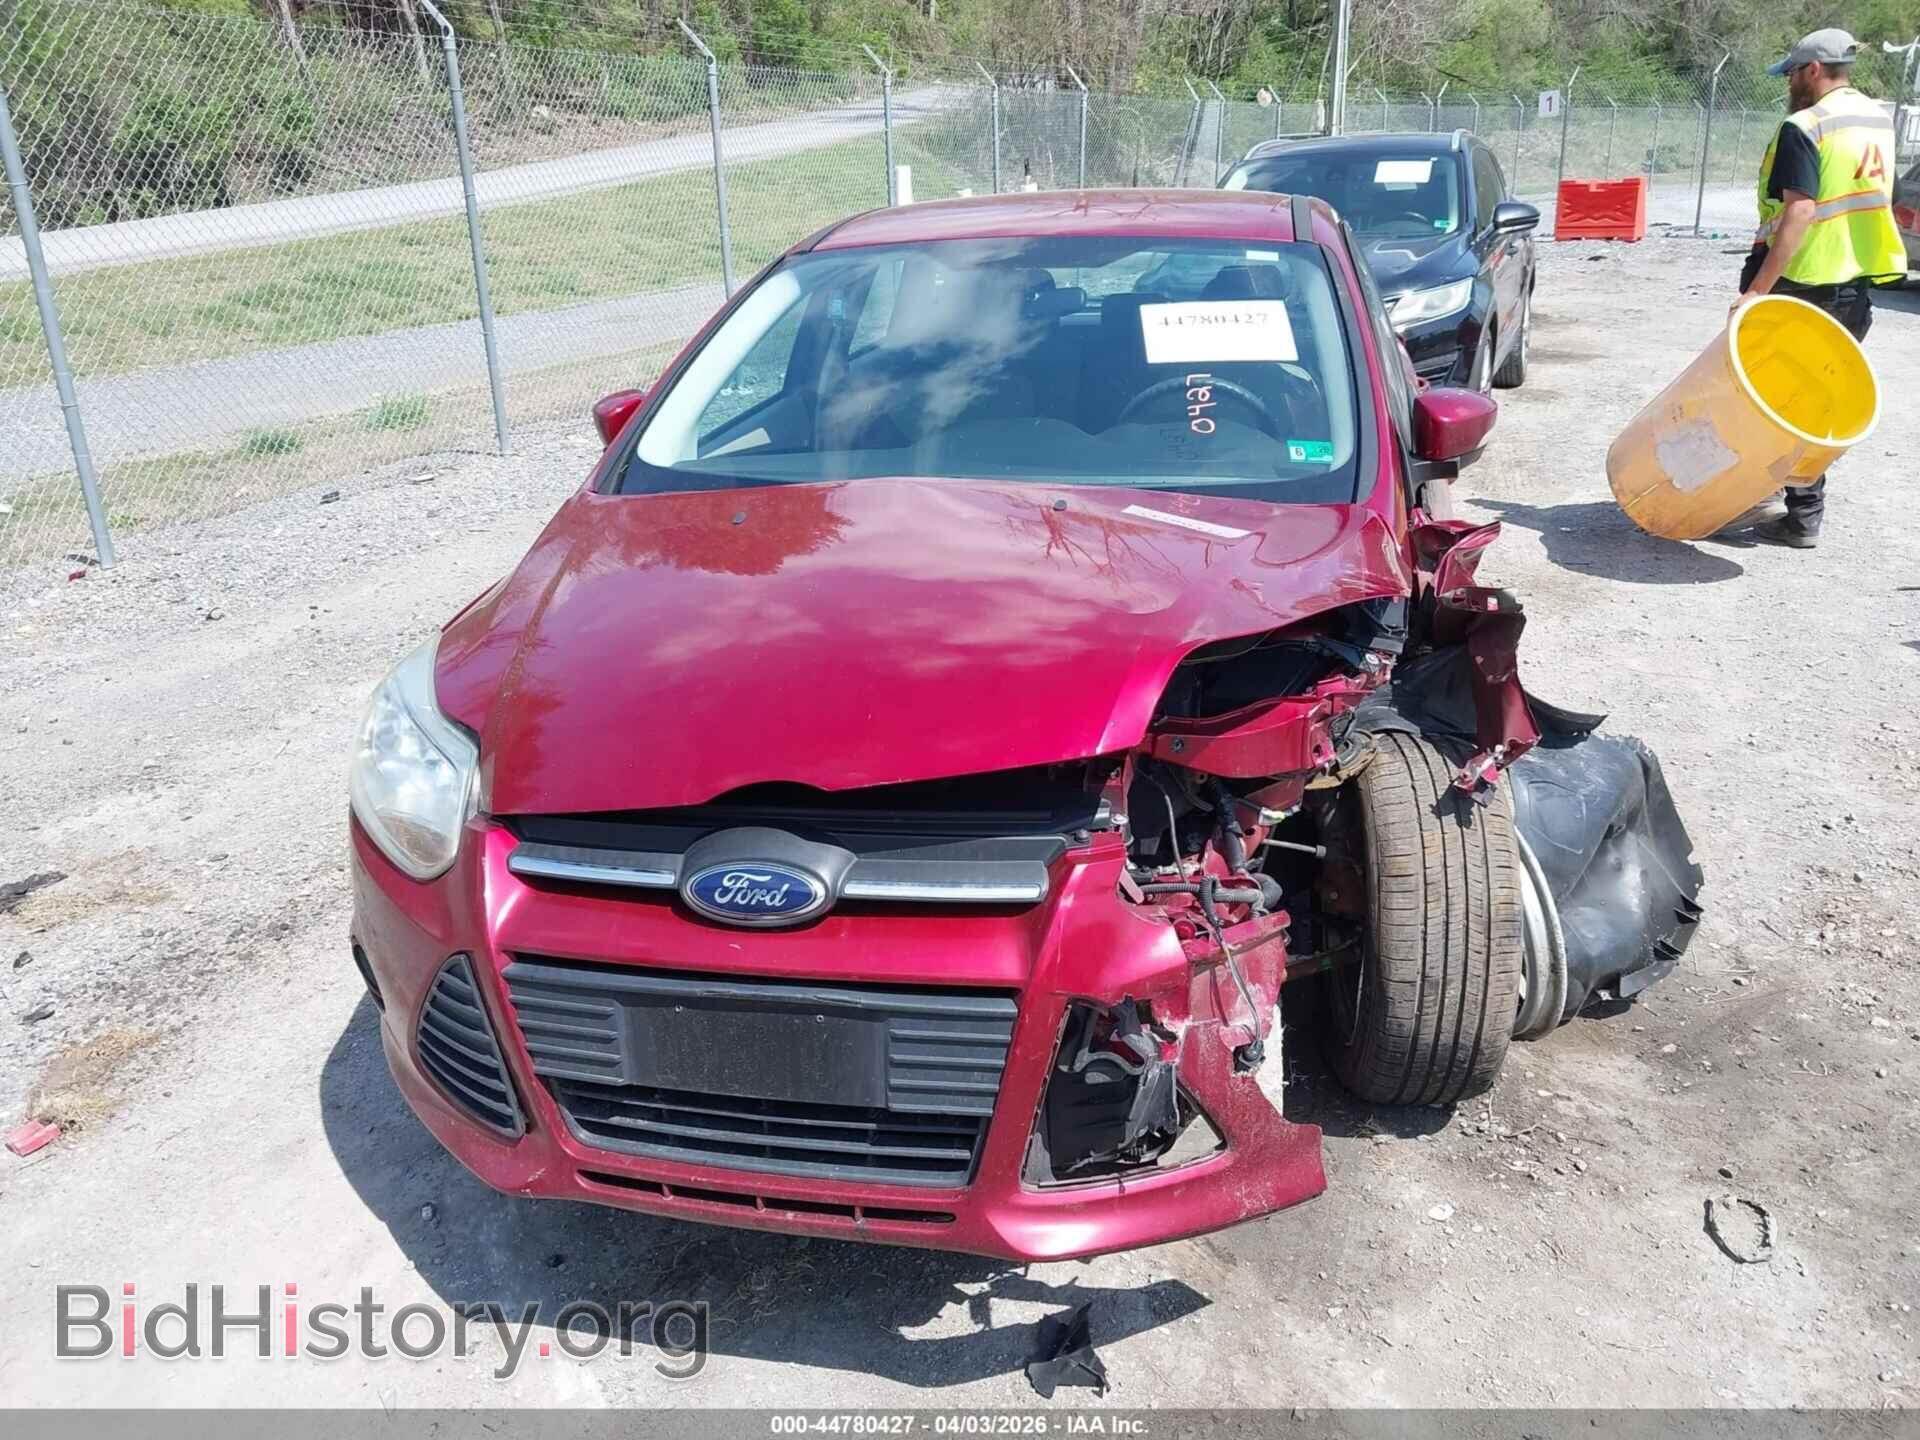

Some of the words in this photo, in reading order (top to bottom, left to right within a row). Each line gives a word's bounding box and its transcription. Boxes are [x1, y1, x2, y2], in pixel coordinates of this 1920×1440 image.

[1546, 96, 1552, 112] 1
[1186, 373, 1217, 434] 0427
[714, 872, 791, 907] Ford
